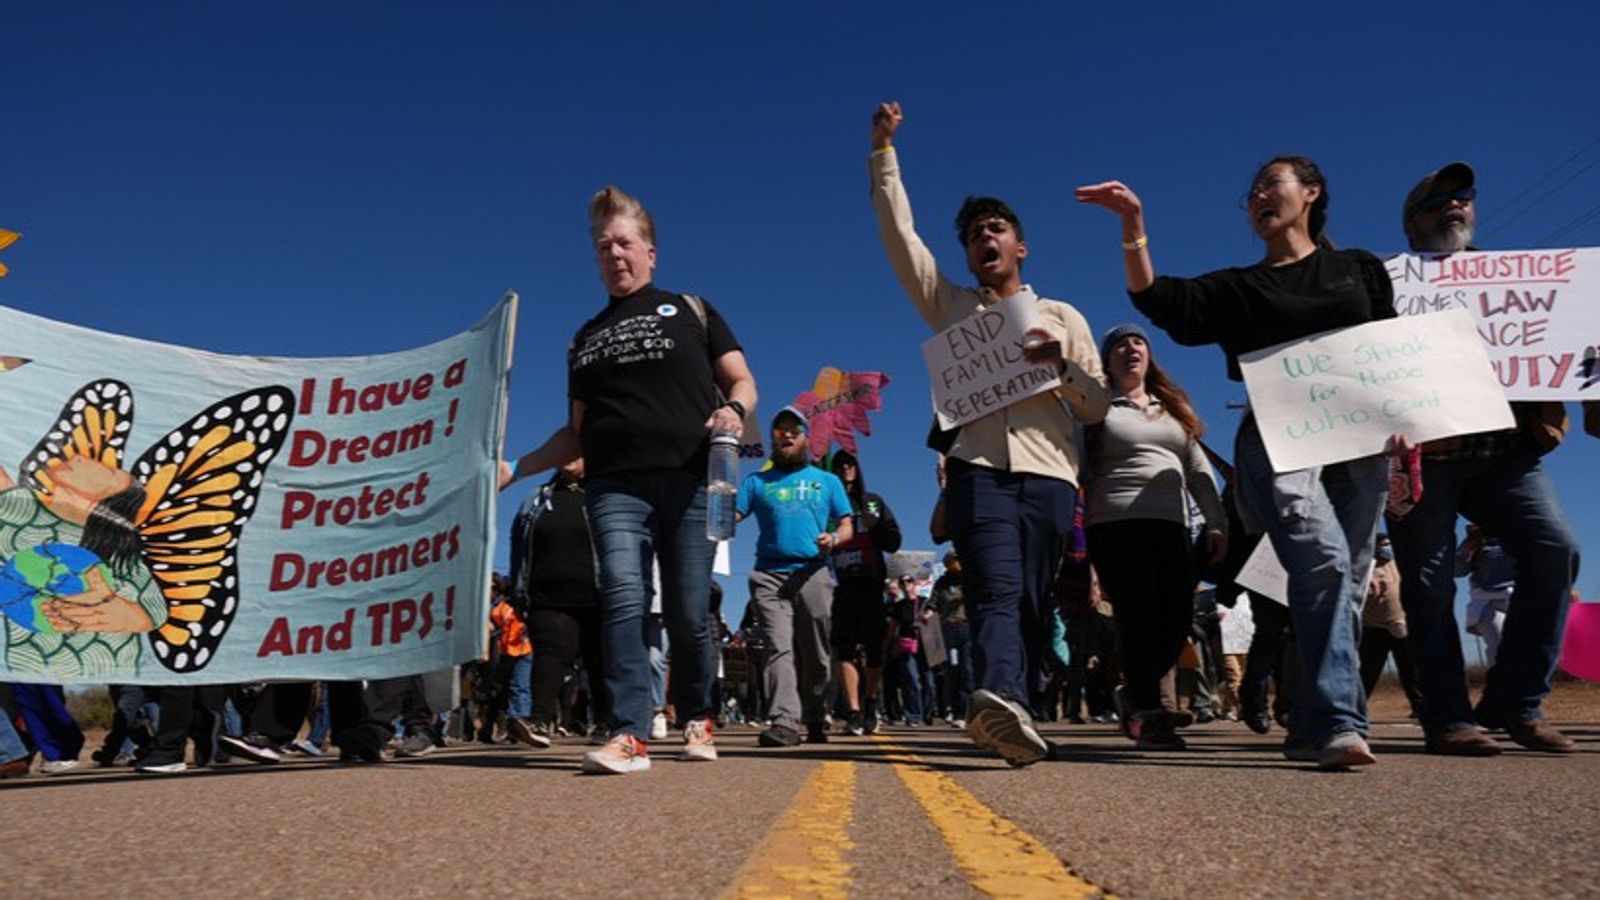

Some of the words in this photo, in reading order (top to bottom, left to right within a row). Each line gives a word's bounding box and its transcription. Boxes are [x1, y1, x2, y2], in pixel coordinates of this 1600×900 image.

[1386, 255, 1425, 282] EN
[1429, 249, 1576, 283] INJUSTICE
[1393, 290, 1469, 316] COMES
[1479, 289, 1557, 318] LAW
[643, 338, 675, 350] GOD
[946, 311, 1005, 361] END
[1477, 319, 1549, 347] NCE
[299, 377, 316, 415] I
[327, 373, 434, 415] have
[443, 358, 468, 388] a
[942, 336, 1025, 389] FAMILY
[1282, 353, 1334, 379] We
[1491, 353, 1575, 389] UTY
[943, 367, 1058, 423] SEPERATION
[287, 419, 434, 467] Dream
[280, 472, 430, 529] Protect
[268, 524, 461, 592] Dreamers
[256, 608, 356, 658] And
[366, 592, 434, 646] TPS
